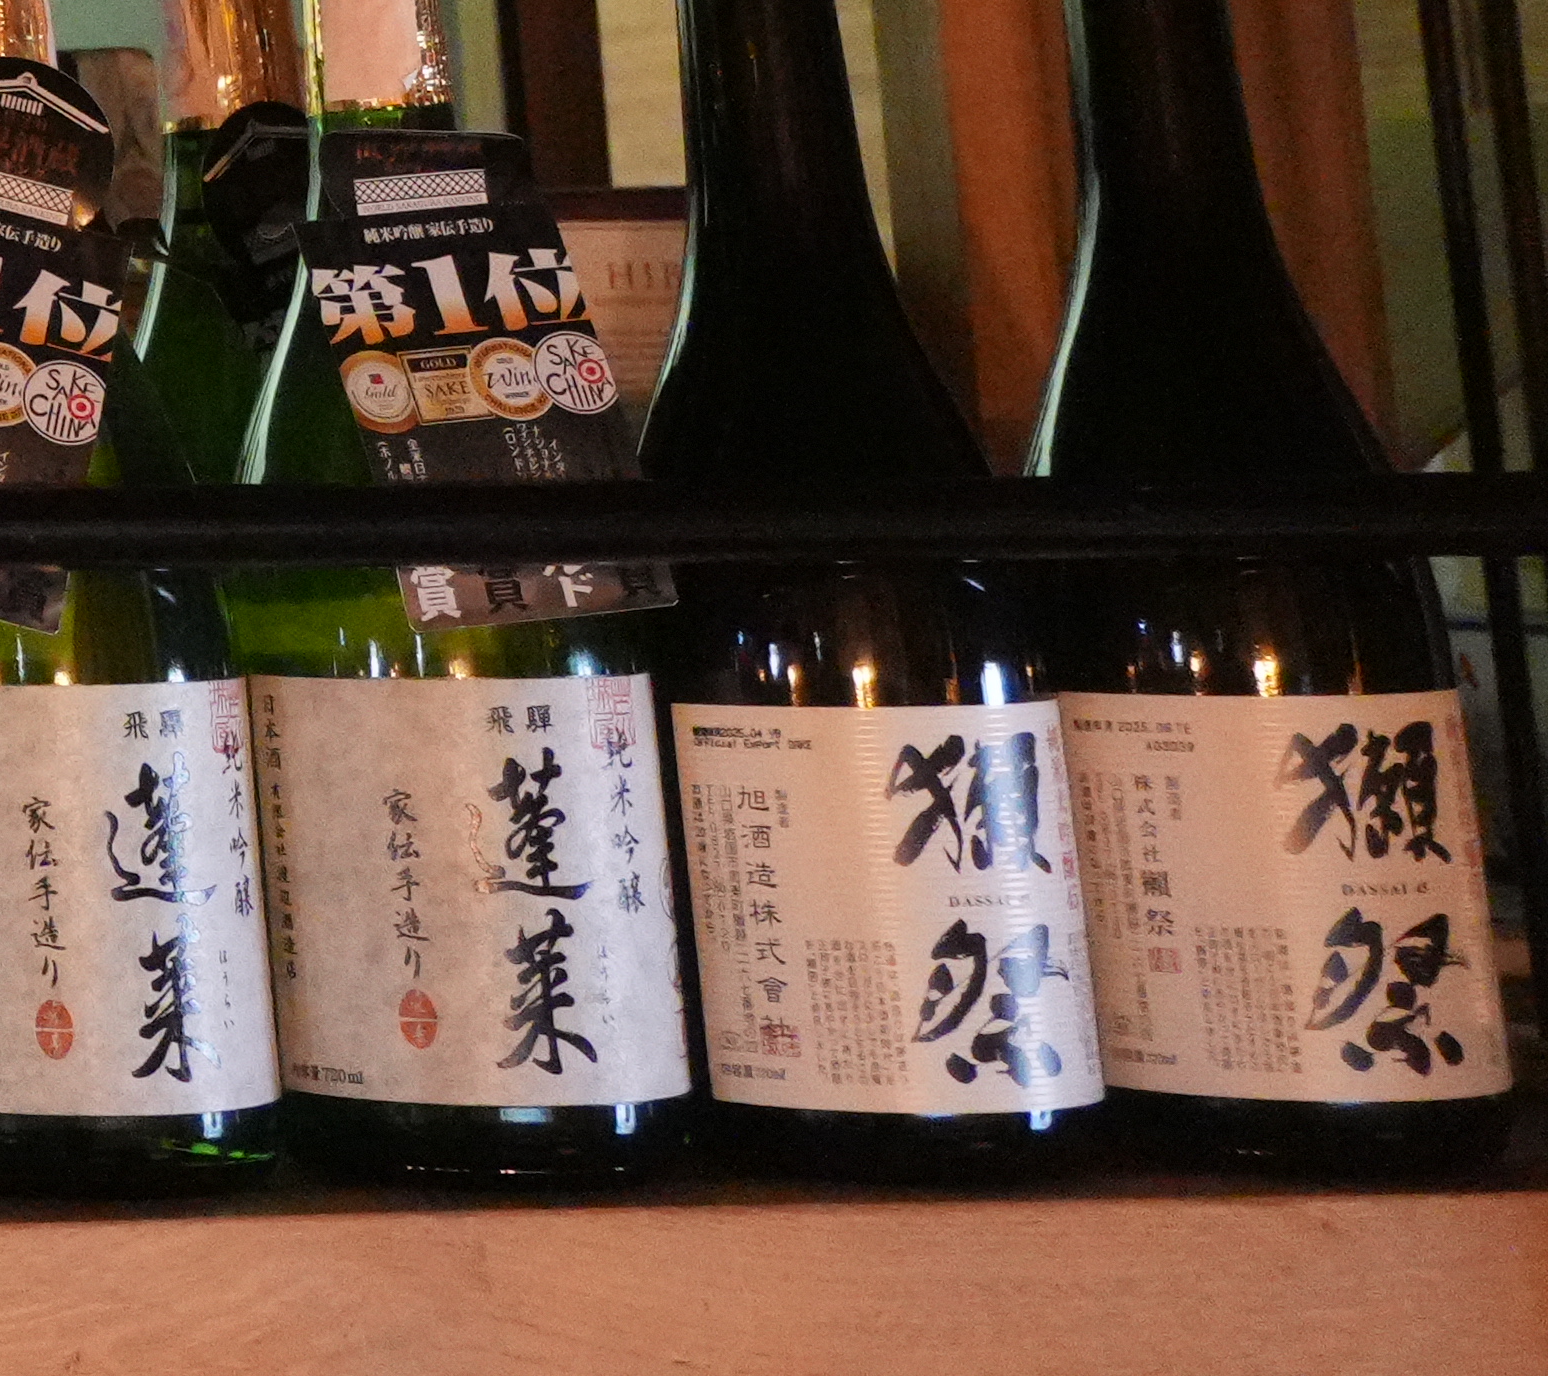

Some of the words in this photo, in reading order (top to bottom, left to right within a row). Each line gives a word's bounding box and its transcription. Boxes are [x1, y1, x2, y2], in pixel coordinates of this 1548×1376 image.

[311, 248, 593, 346] 第1位
[419, 357, 457, 371] GOLD
[546, 338, 605, 376] SAKE
[46, 368, 100, 403] SAKE
[423, 380, 470, 398] SAKE
[546, 373, 613, 410] CHINA
[29, 393, 98, 440] CHINA
[259, 693, 283, 771] 日本酒
[602, 730, 648, 916] 純米吟醸
[20, 796, 67, 989] 家伝手造り
[382, 786, 430, 982] 家伝手造り
[1273, 718, 1471, 1077] 獺祭
[1342, 883, 1408, 896] DASSAI
